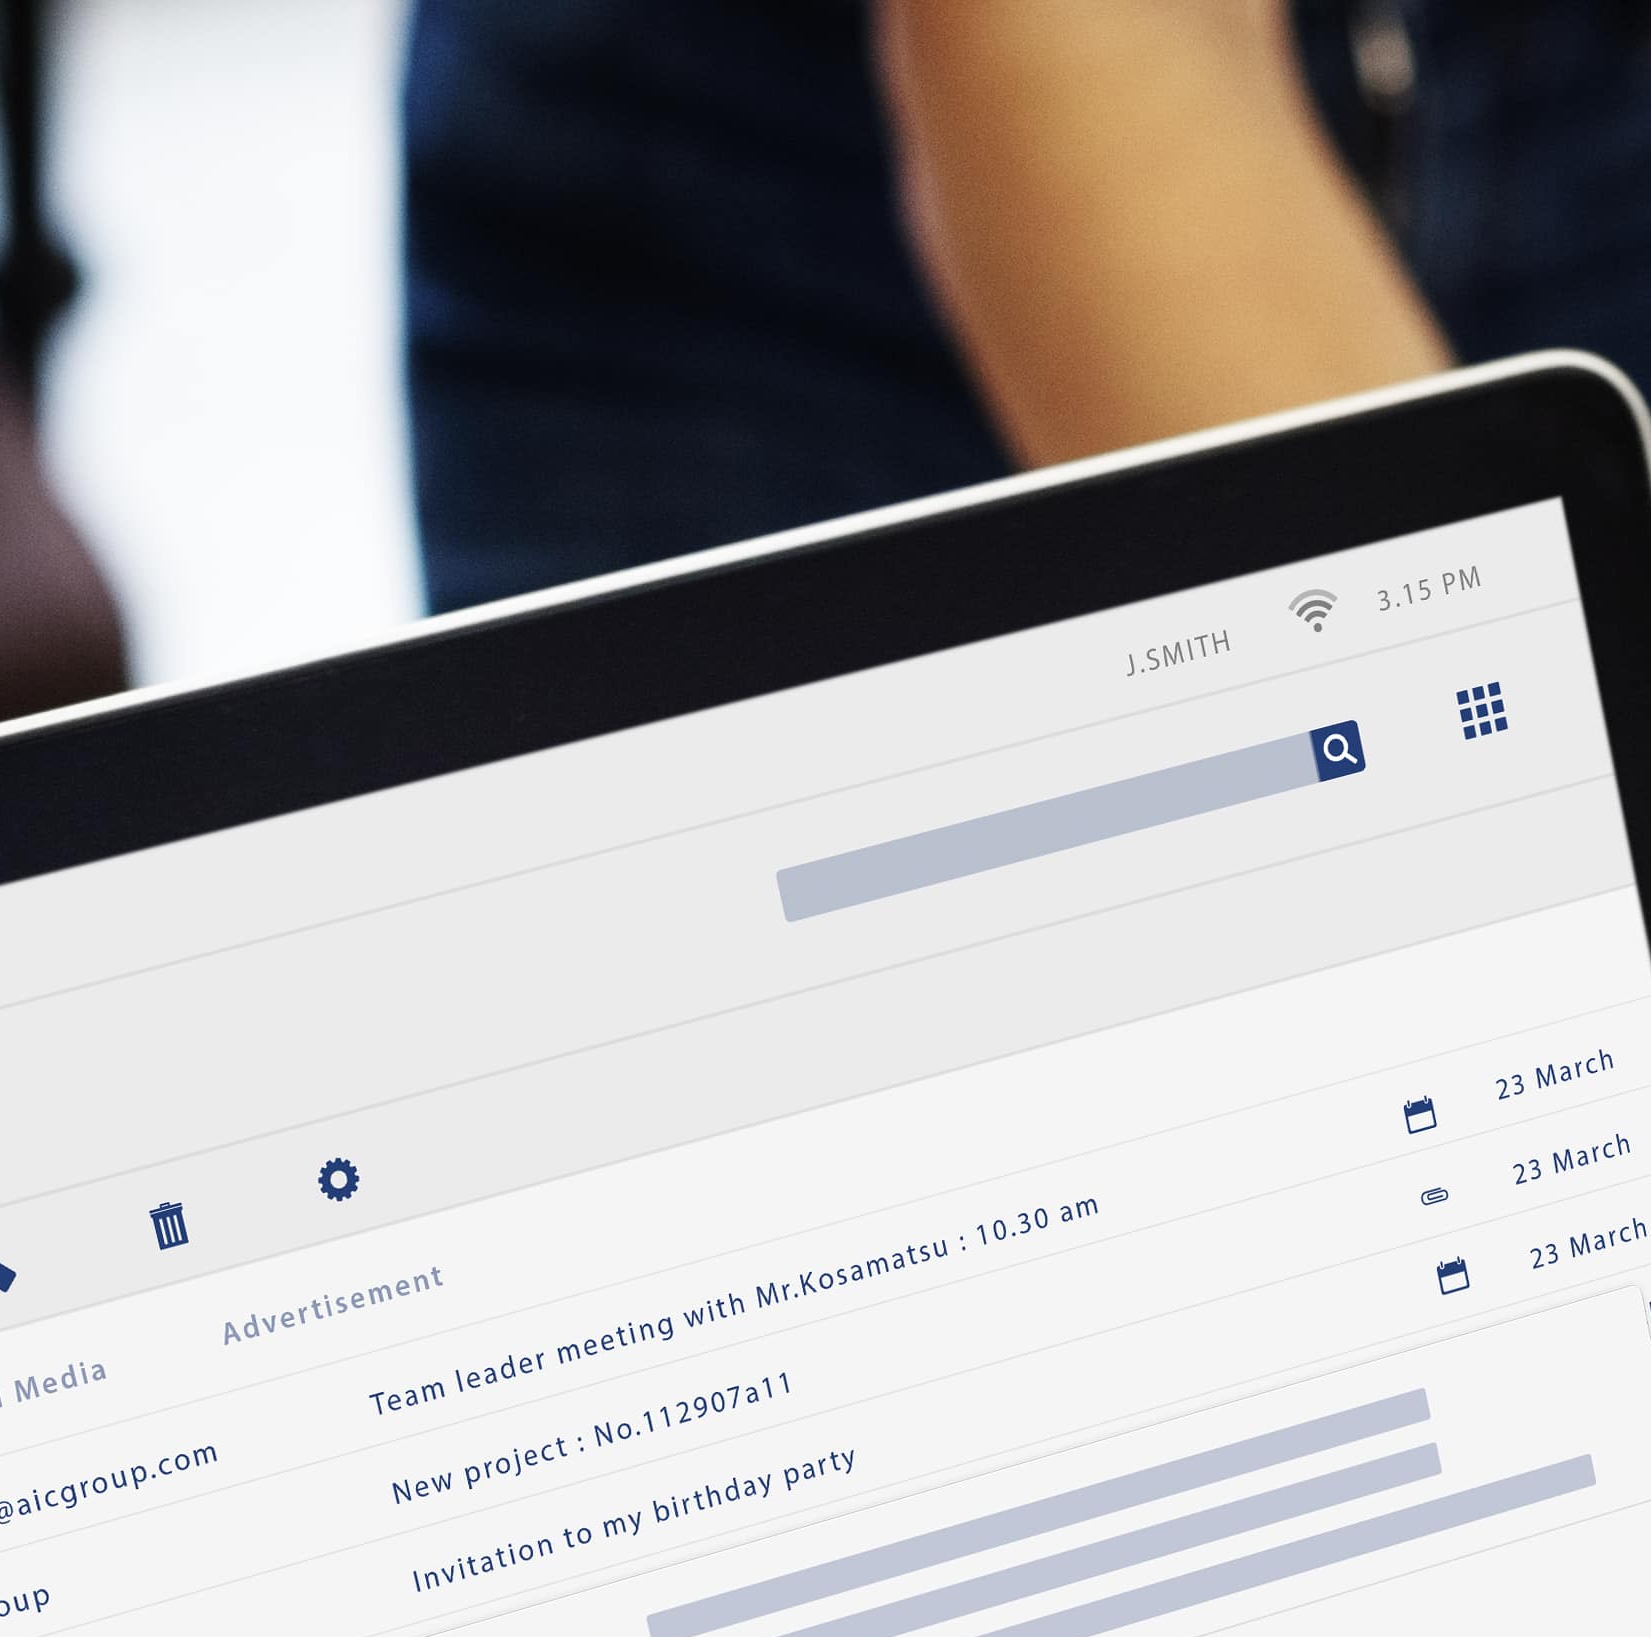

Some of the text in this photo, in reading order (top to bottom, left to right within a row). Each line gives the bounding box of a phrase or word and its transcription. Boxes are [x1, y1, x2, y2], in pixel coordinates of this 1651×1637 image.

[1377, 565, 1481, 612] 3.15 PM
[1126, 629, 1231, 677] J.SMITH
[1495, 1048, 1614, 1101] 23 March
[1512, 1132, 1631, 1186] 23 March
[1529, 1217, 1648, 1270] 23 March
[223, 1266, 444, 1346] Advertisement
[368, 1381, 446, 1416] Team
[454, 1351, 545, 1393] leader
[556, 1316, 674, 1365] meeting
[682, 1292, 746, 1328] with
[755, 1239, 949, 1309] Mr.Kosamatsu
[976, 1207, 1049, 1246] 10.30
[1059, 1198, 1099, 1223] am
[14, 1361, 107, 1403] Media
[391, 1471, 452, 1505] New
[464, 1436, 569, 1491] project
[593, 1371, 790, 1448] No.112907a11
[412, 1449, 855, 1593] Invitation to my birthday party
